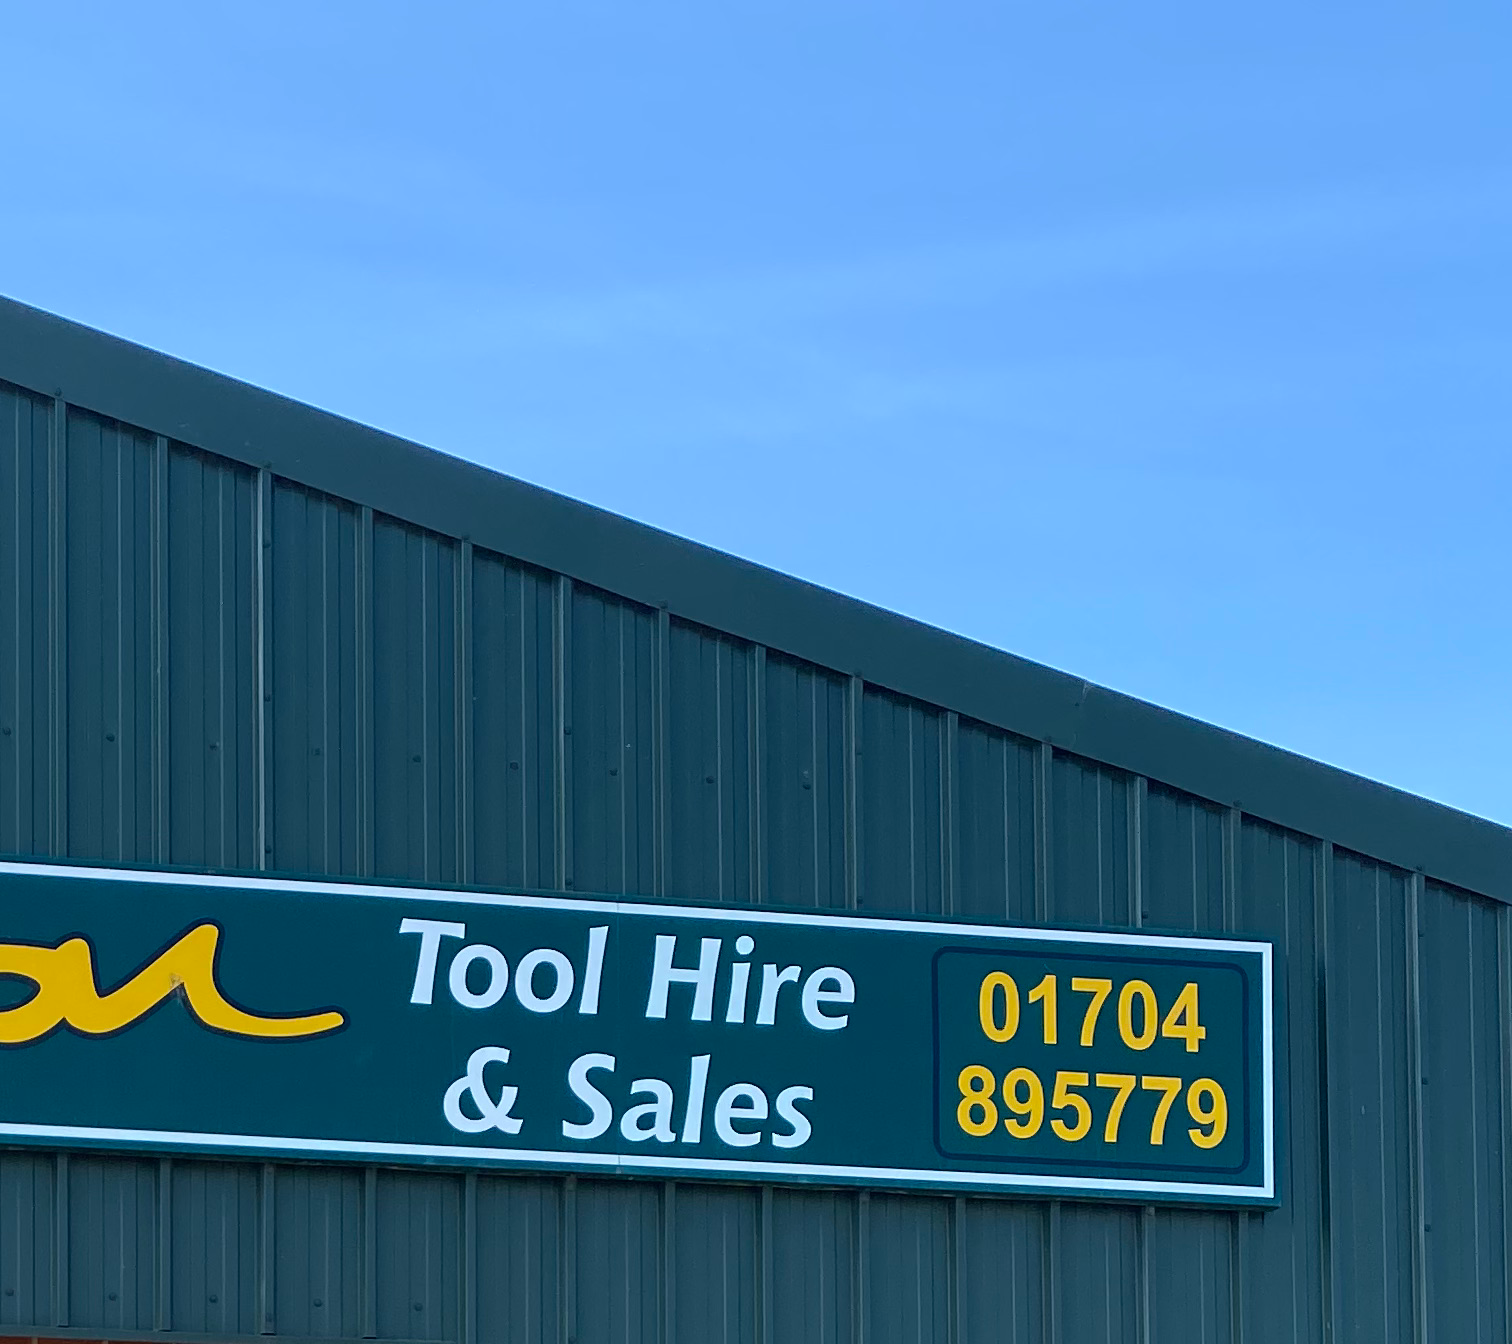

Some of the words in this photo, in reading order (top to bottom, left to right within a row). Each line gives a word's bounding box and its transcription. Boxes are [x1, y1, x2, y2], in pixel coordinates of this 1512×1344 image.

[399, 917, 610, 1015] Tool
[645, 934, 857, 1032] Hire
[977, 970, 1207, 1054] 01704
[442, 1046, 524, 1136] &
[561, 1052, 815, 1149] Sales
[955, 1064, 1230, 1150] 895779
